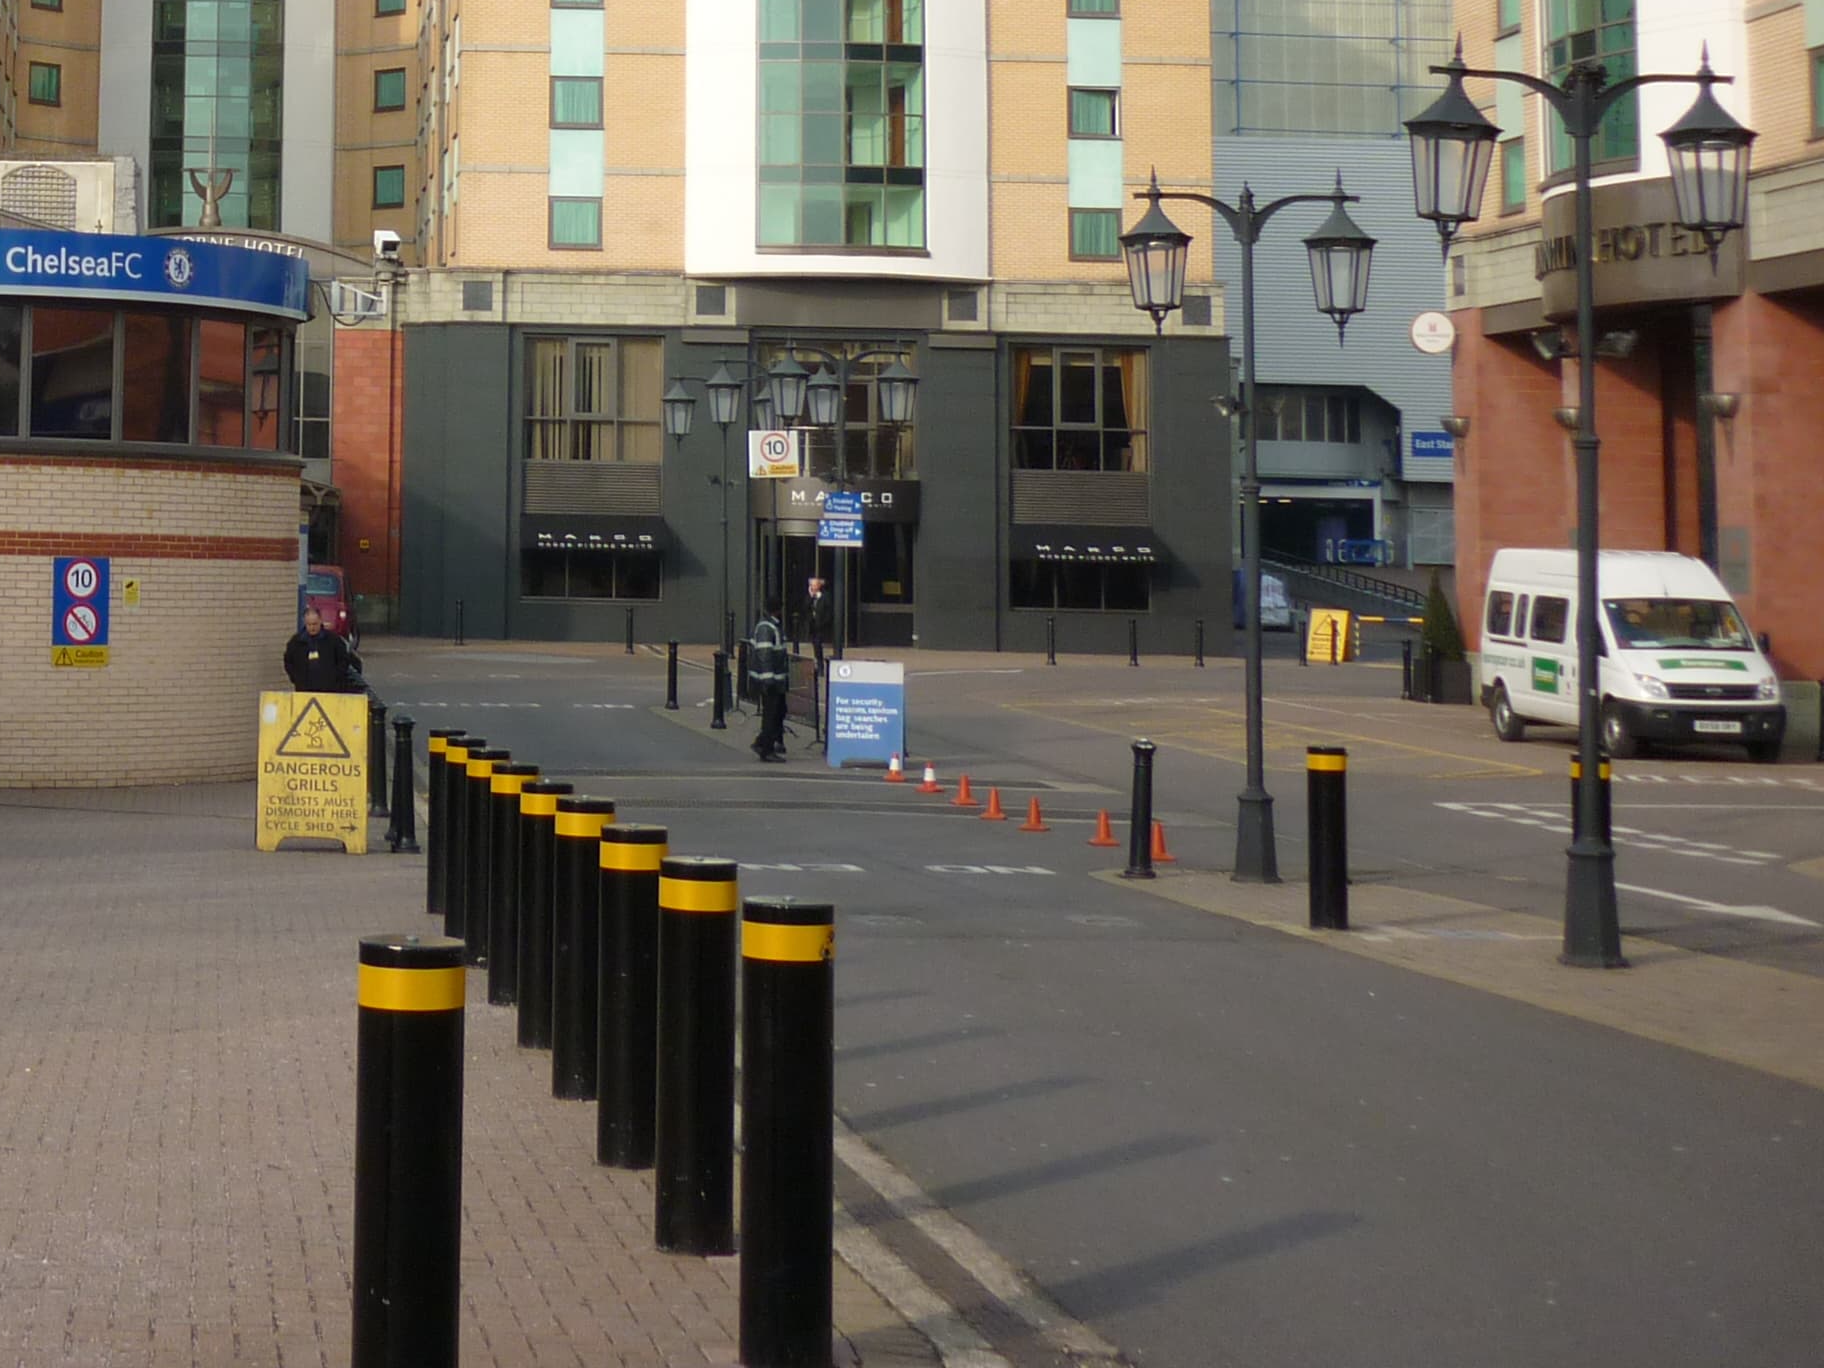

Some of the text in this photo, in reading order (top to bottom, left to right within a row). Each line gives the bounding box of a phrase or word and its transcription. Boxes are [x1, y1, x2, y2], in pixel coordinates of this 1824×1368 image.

[1592, 222, 1708, 263] HOTEL
[6, 246, 143, 279] ChelseaFC
[766, 439, 785, 455] 10
[1415, 438, 1454, 449] East Sta
[791, 489, 893, 504] MACO
[71, 568, 93, 589] 10
[263, 761, 361, 777] DANGEROUS
[286, 778, 338, 792] GRILLS
[268, 795, 356, 807] CYCLISTS MUST
[265, 806, 360, 819] DISMOUNT HERE
[264, 820, 335, 832] CYCLE SHED
